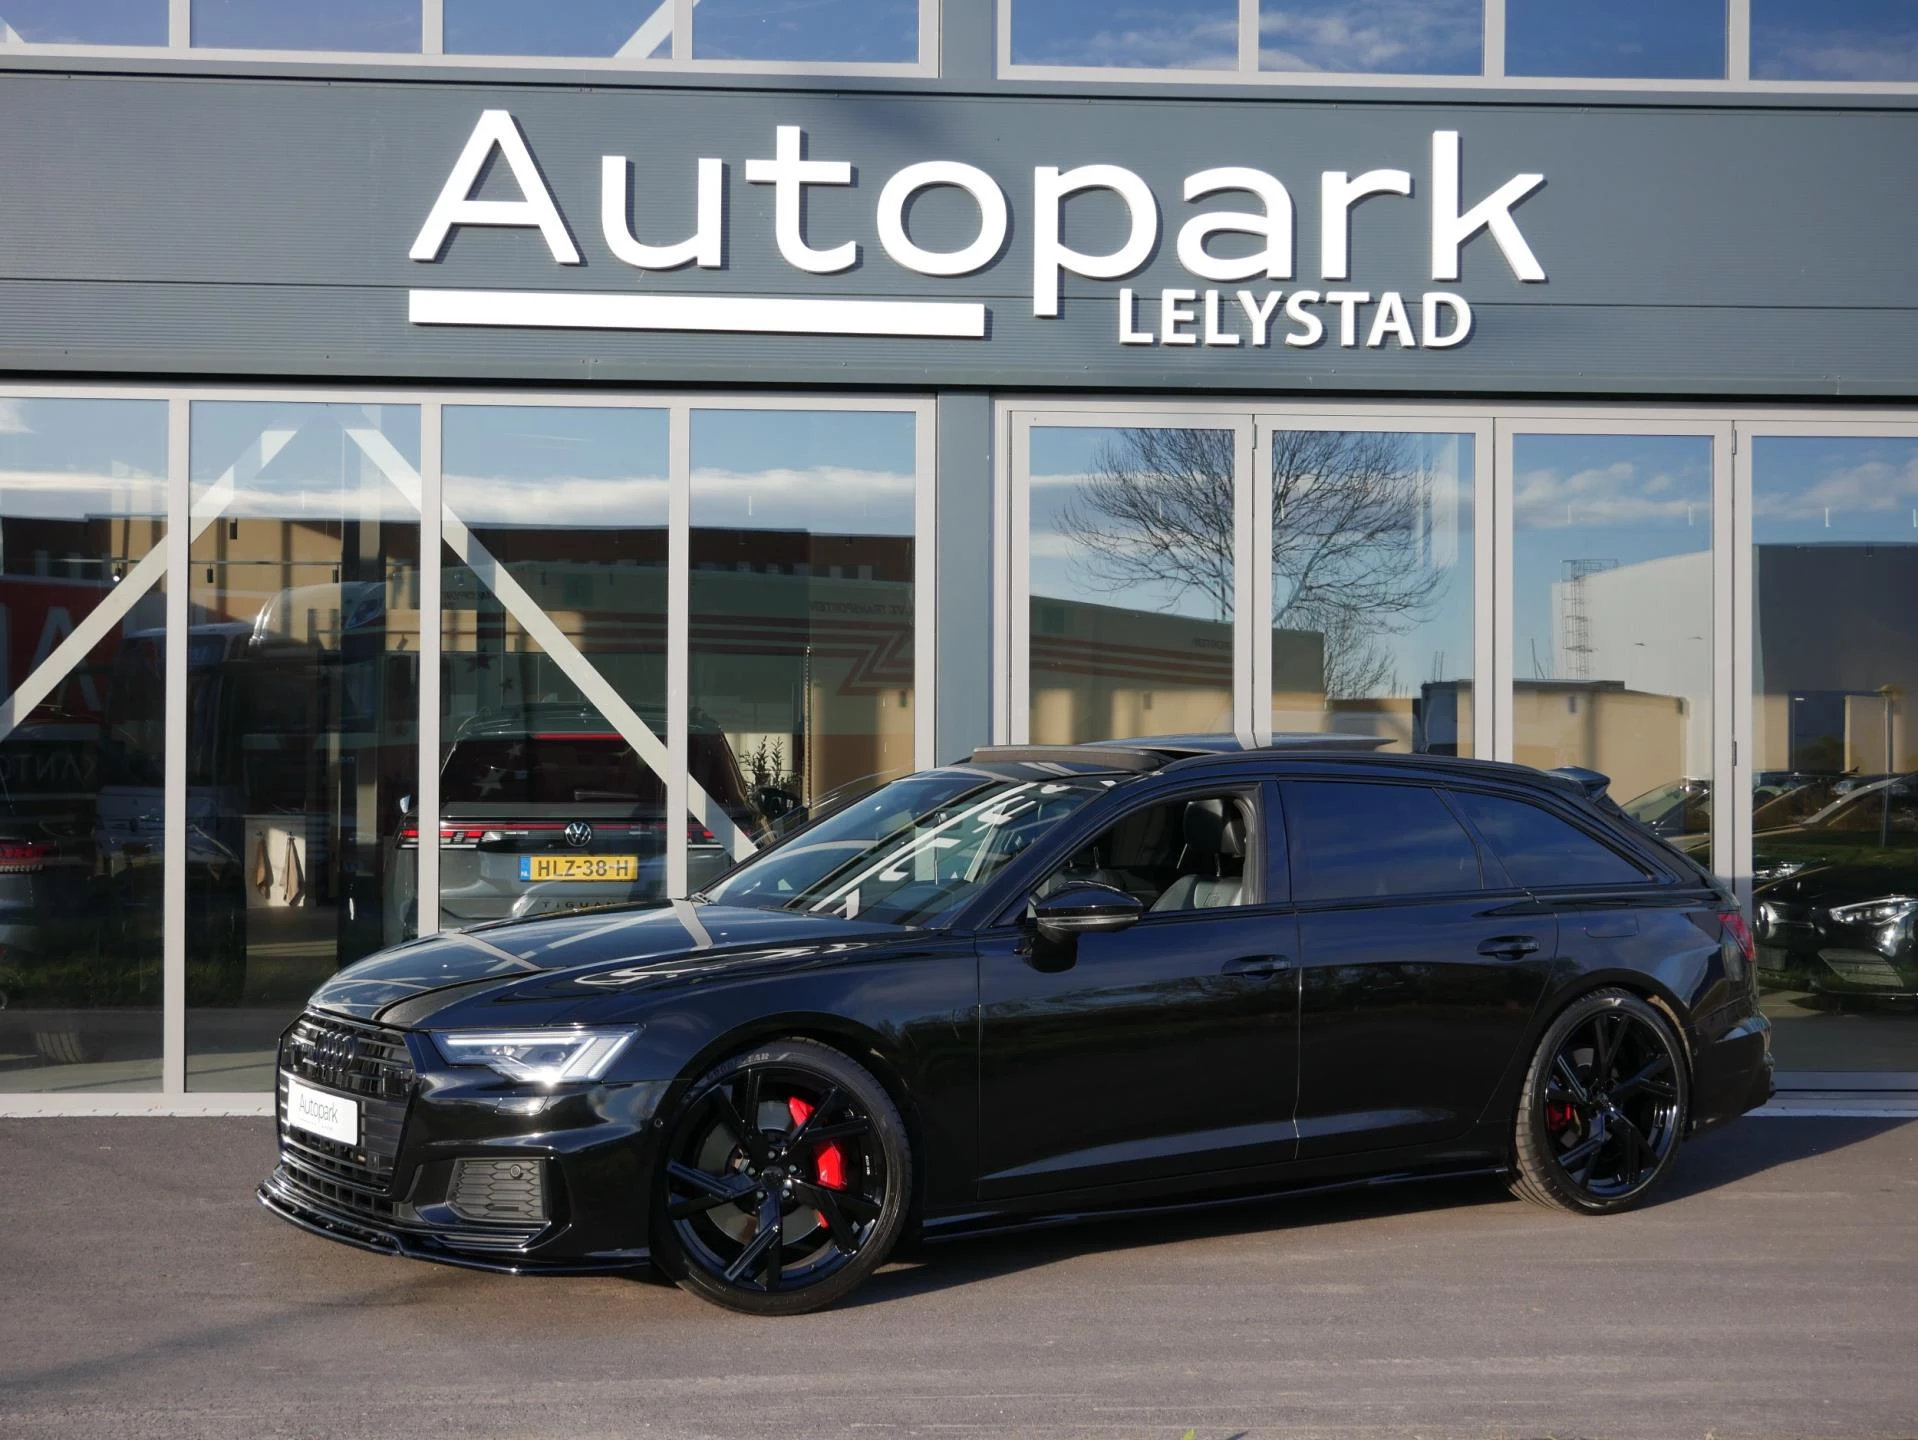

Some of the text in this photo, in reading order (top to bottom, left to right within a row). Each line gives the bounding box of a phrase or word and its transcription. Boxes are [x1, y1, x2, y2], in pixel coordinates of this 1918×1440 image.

[408, 109, 1546, 317] Autopark
[1119, 288, 1472, 348] LELYSTAD
[537, 859, 629, 877] HLZ-38-H
[299, 1093, 339, 1124] Autopark
